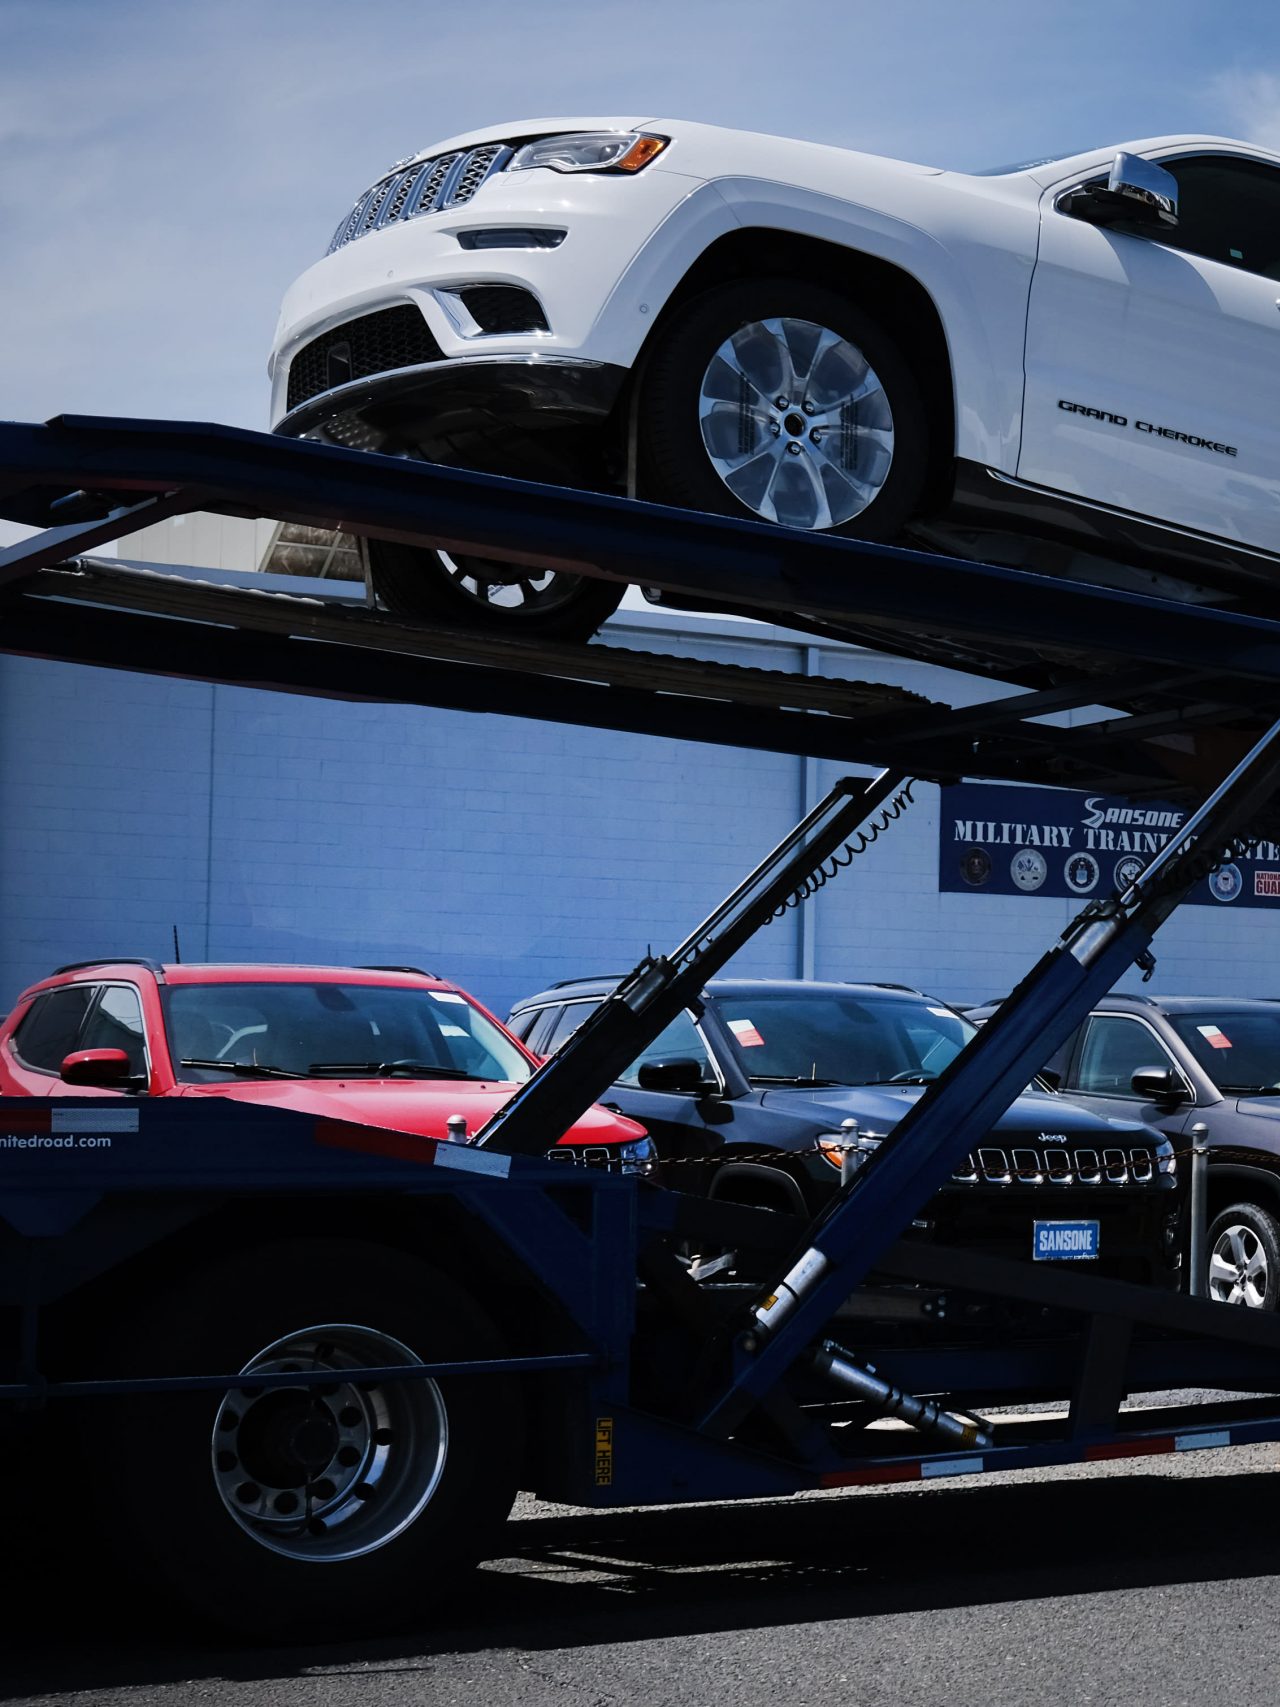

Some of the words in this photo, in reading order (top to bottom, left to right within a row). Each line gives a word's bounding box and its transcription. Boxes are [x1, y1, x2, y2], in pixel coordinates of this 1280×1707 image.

[1058, 400, 1127, 426] GRAND
[1135, 420, 1237, 456] CHEROKEE
[953, 819, 1075, 848] MILITARY
[1037, 1132, 1067, 1143] Jeep
[1039, 1230, 1093, 1251] SANSONE
[598, 1419, 611, 1444] LIFT
[597, 1450, 610, 1483] HERE
